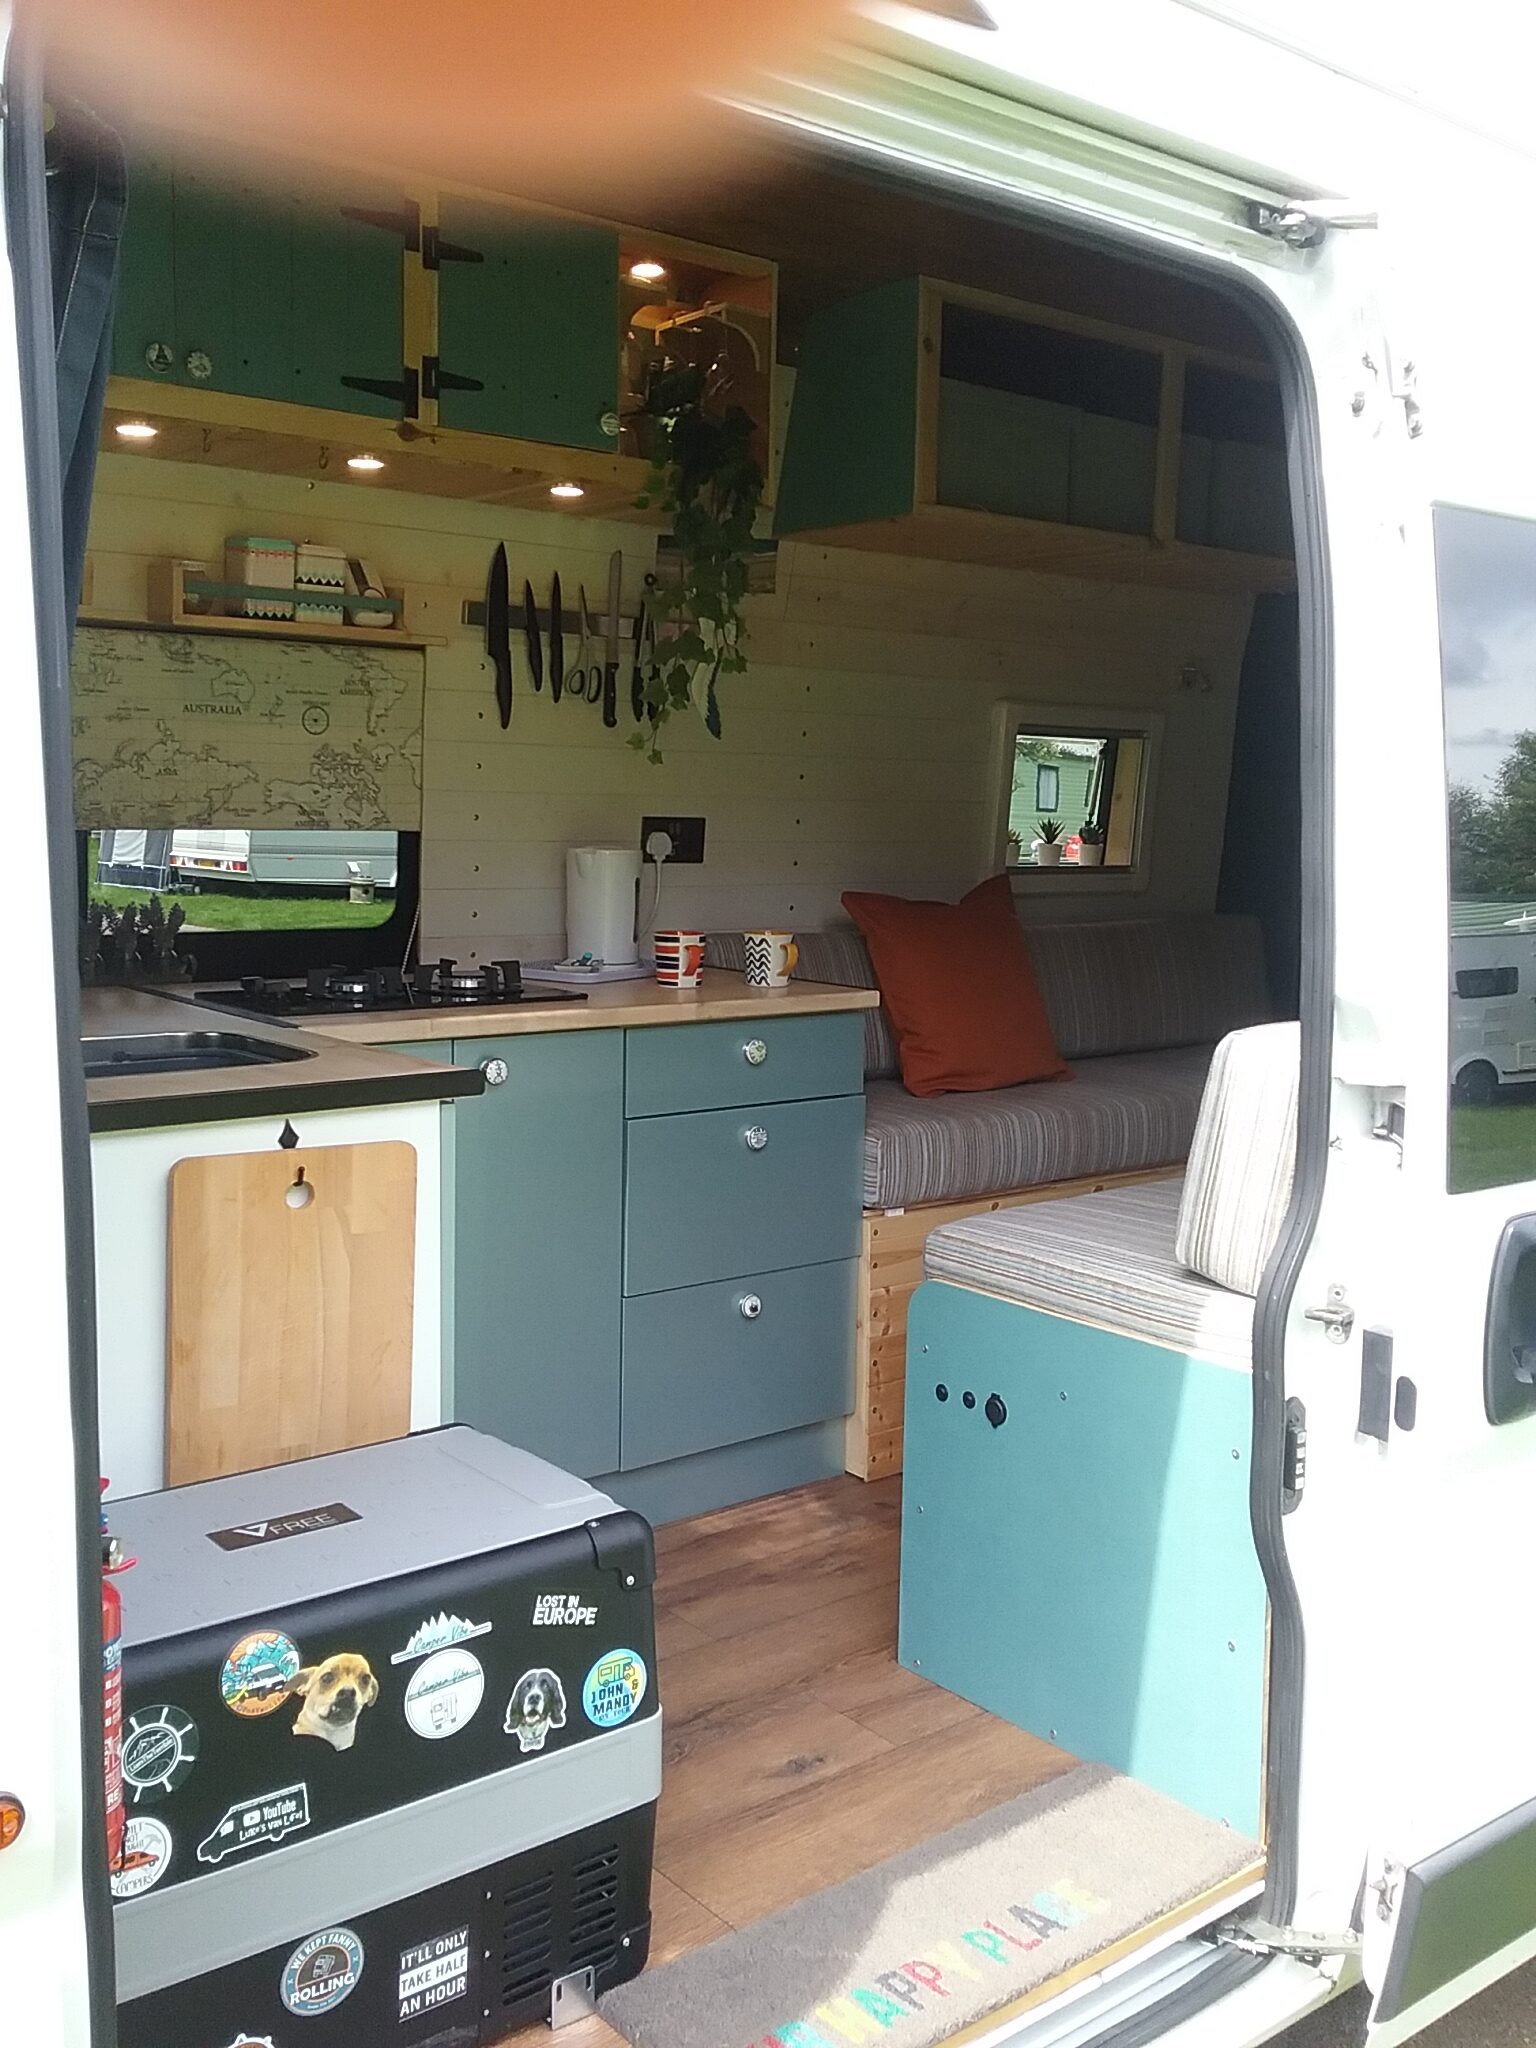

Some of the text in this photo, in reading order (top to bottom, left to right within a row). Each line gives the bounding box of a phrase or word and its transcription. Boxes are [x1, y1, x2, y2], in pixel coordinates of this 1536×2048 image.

[182, 703, 242, 716] AUSTRALIA
[155, 767, 178, 777] ASIA
[536, 1594, 580, 1608] LOST IN
[533, 1607, 598, 1625] EUROPE
[591, 1679, 639, 1704] JOHN &
[592, 1692, 637, 1717] MANDY
[262, 1799, 296, 1820] YouTube
[116, 1875, 154, 1895] CAMPERS
[290, 1933, 356, 1970] WE KEPT FANNY
[401, 1930, 467, 1970] IT'LL ONLY
[401, 1954, 467, 1993] TAKE HALF
[290, 1972, 355, 2005] ROLLING
[400, 1976, 466, 2017] AN HOUR
